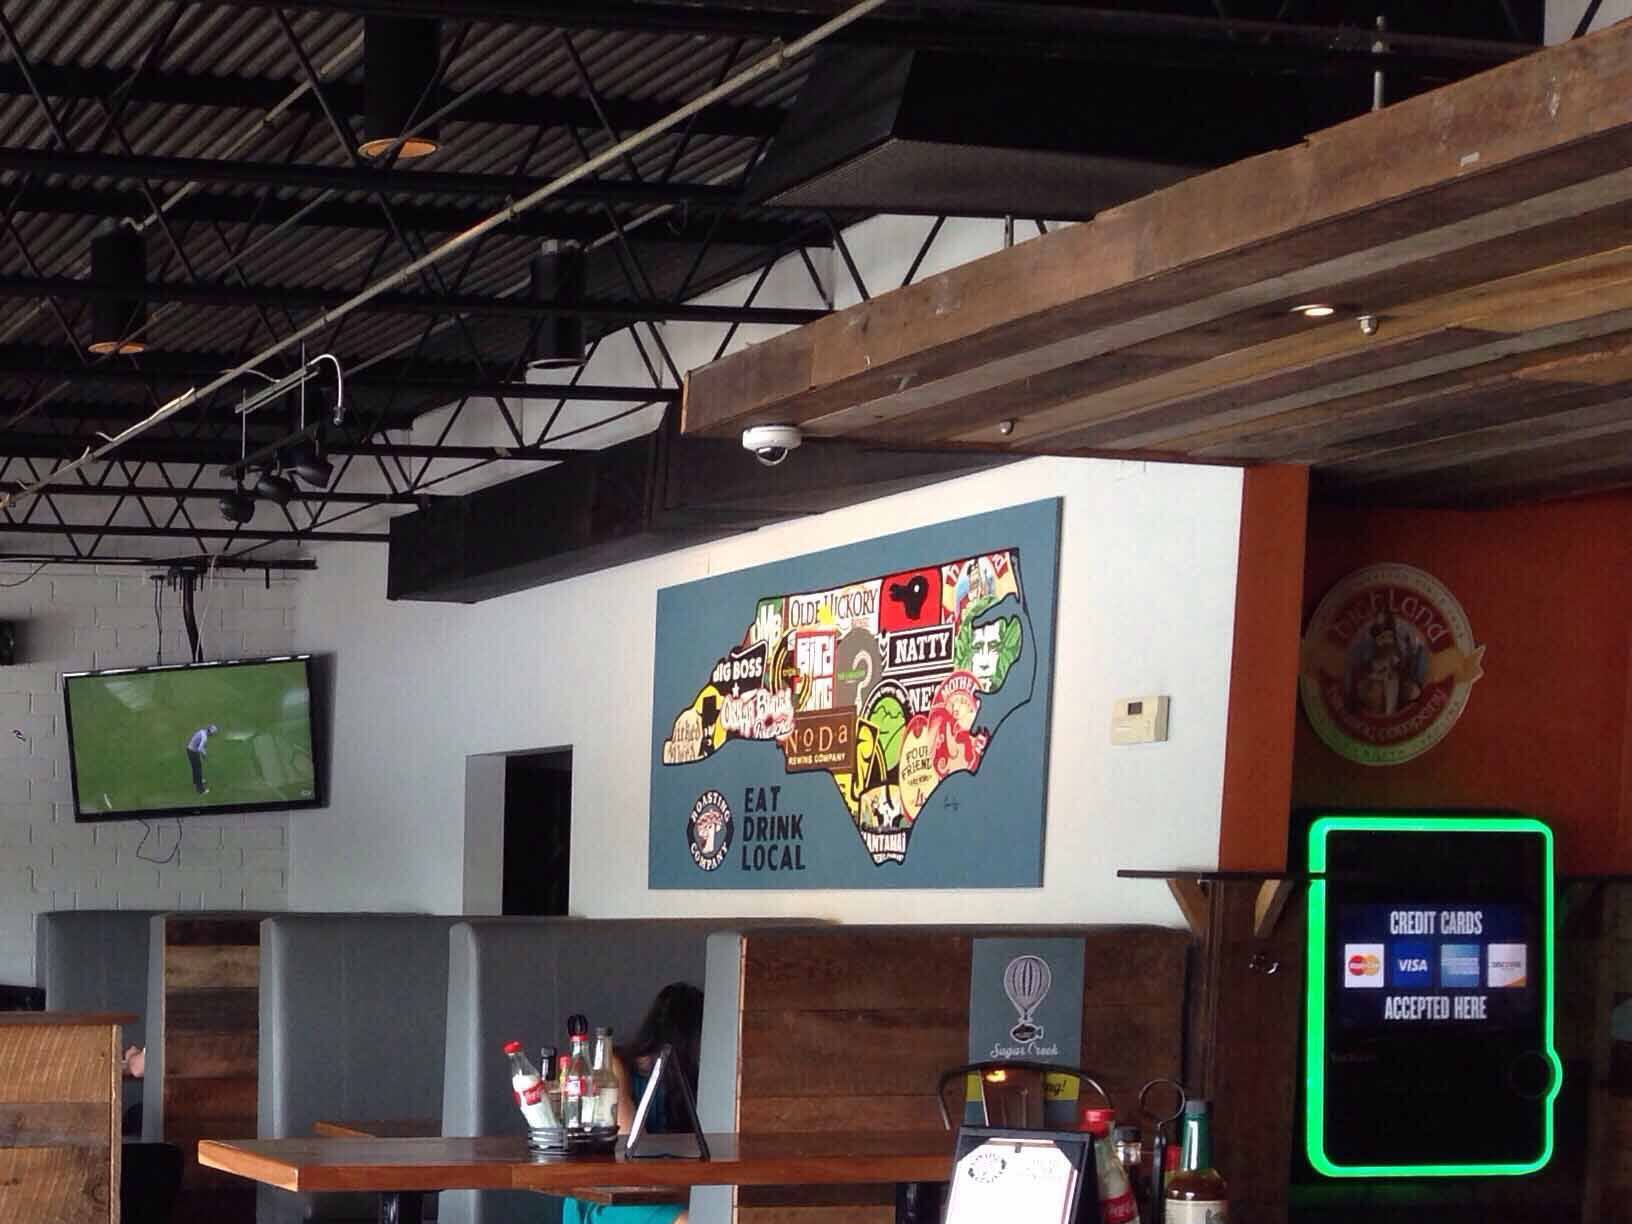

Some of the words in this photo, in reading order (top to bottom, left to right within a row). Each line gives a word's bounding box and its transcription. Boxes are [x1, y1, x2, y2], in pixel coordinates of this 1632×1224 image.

[894, 632, 950, 663] NATTY
[733, 656, 762, 680] BOSS
[814, 753, 846, 762] COMPANY
[691, 792, 731, 822] ROASTING
[744, 785, 781, 813] EAT
[743, 814, 804, 841] DRINK
[690, 842, 728, 870] COMPANY
[741, 844, 806, 871] LOCAL
[1390, 911, 1436, 934] CREDIT
[1441, 911, 1483, 934] CARDS
[1398, 959, 1428, 972] VISA
[1385, 996, 1450, 1019] ACCEPTED
[1454, 996, 1487, 1019] HERE
[990, 1043, 1026, 1058] Sugar
[1027, 1042, 1058, 1056] Creek
